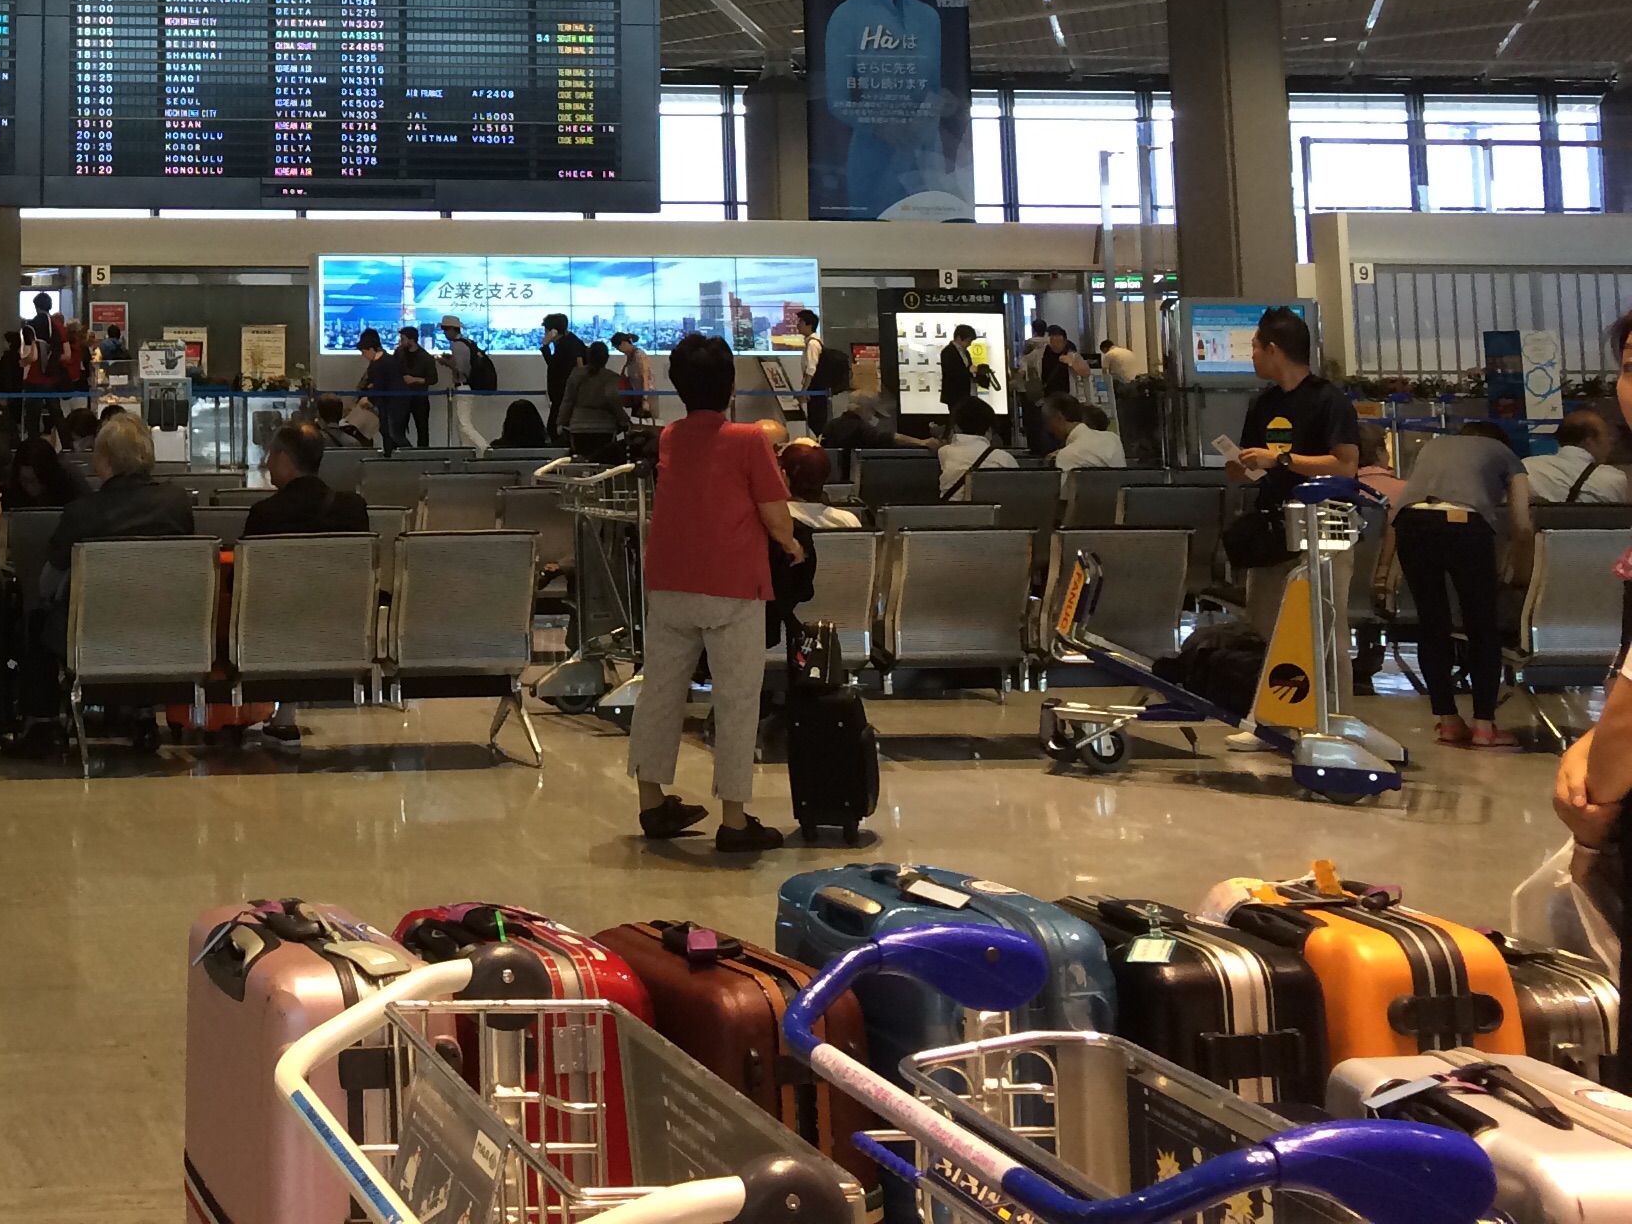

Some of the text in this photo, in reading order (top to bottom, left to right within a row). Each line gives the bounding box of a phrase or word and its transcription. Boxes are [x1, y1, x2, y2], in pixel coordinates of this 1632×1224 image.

[165, 6, 209, 14] MANILA
[860, 24, 918, 50] Hà は
[166, 52, 222, 60] SHANGHAI
[856, 62, 917, 75] さらに先を
[846, 76, 928, 90] 目指し続けます
[165, 86, 195, 94] GUAM
[77, 119, 202, 129] 19:10 BUSAN
[76, 131, 223, 140] 20:00 HONOLULU
[76, 143, 112, 151] 20:25
[76, 154, 223, 163] 21:00 HONOLULU
[76, 165, 615, 178] 21:20 HONOLULU KE1 CHECK IN
[96, 267, 106, 282] 5
[943, 271, 954, 285] 8
[1358, 265, 1370, 281] 9
[437, 281, 534, 299] 企業を支える
